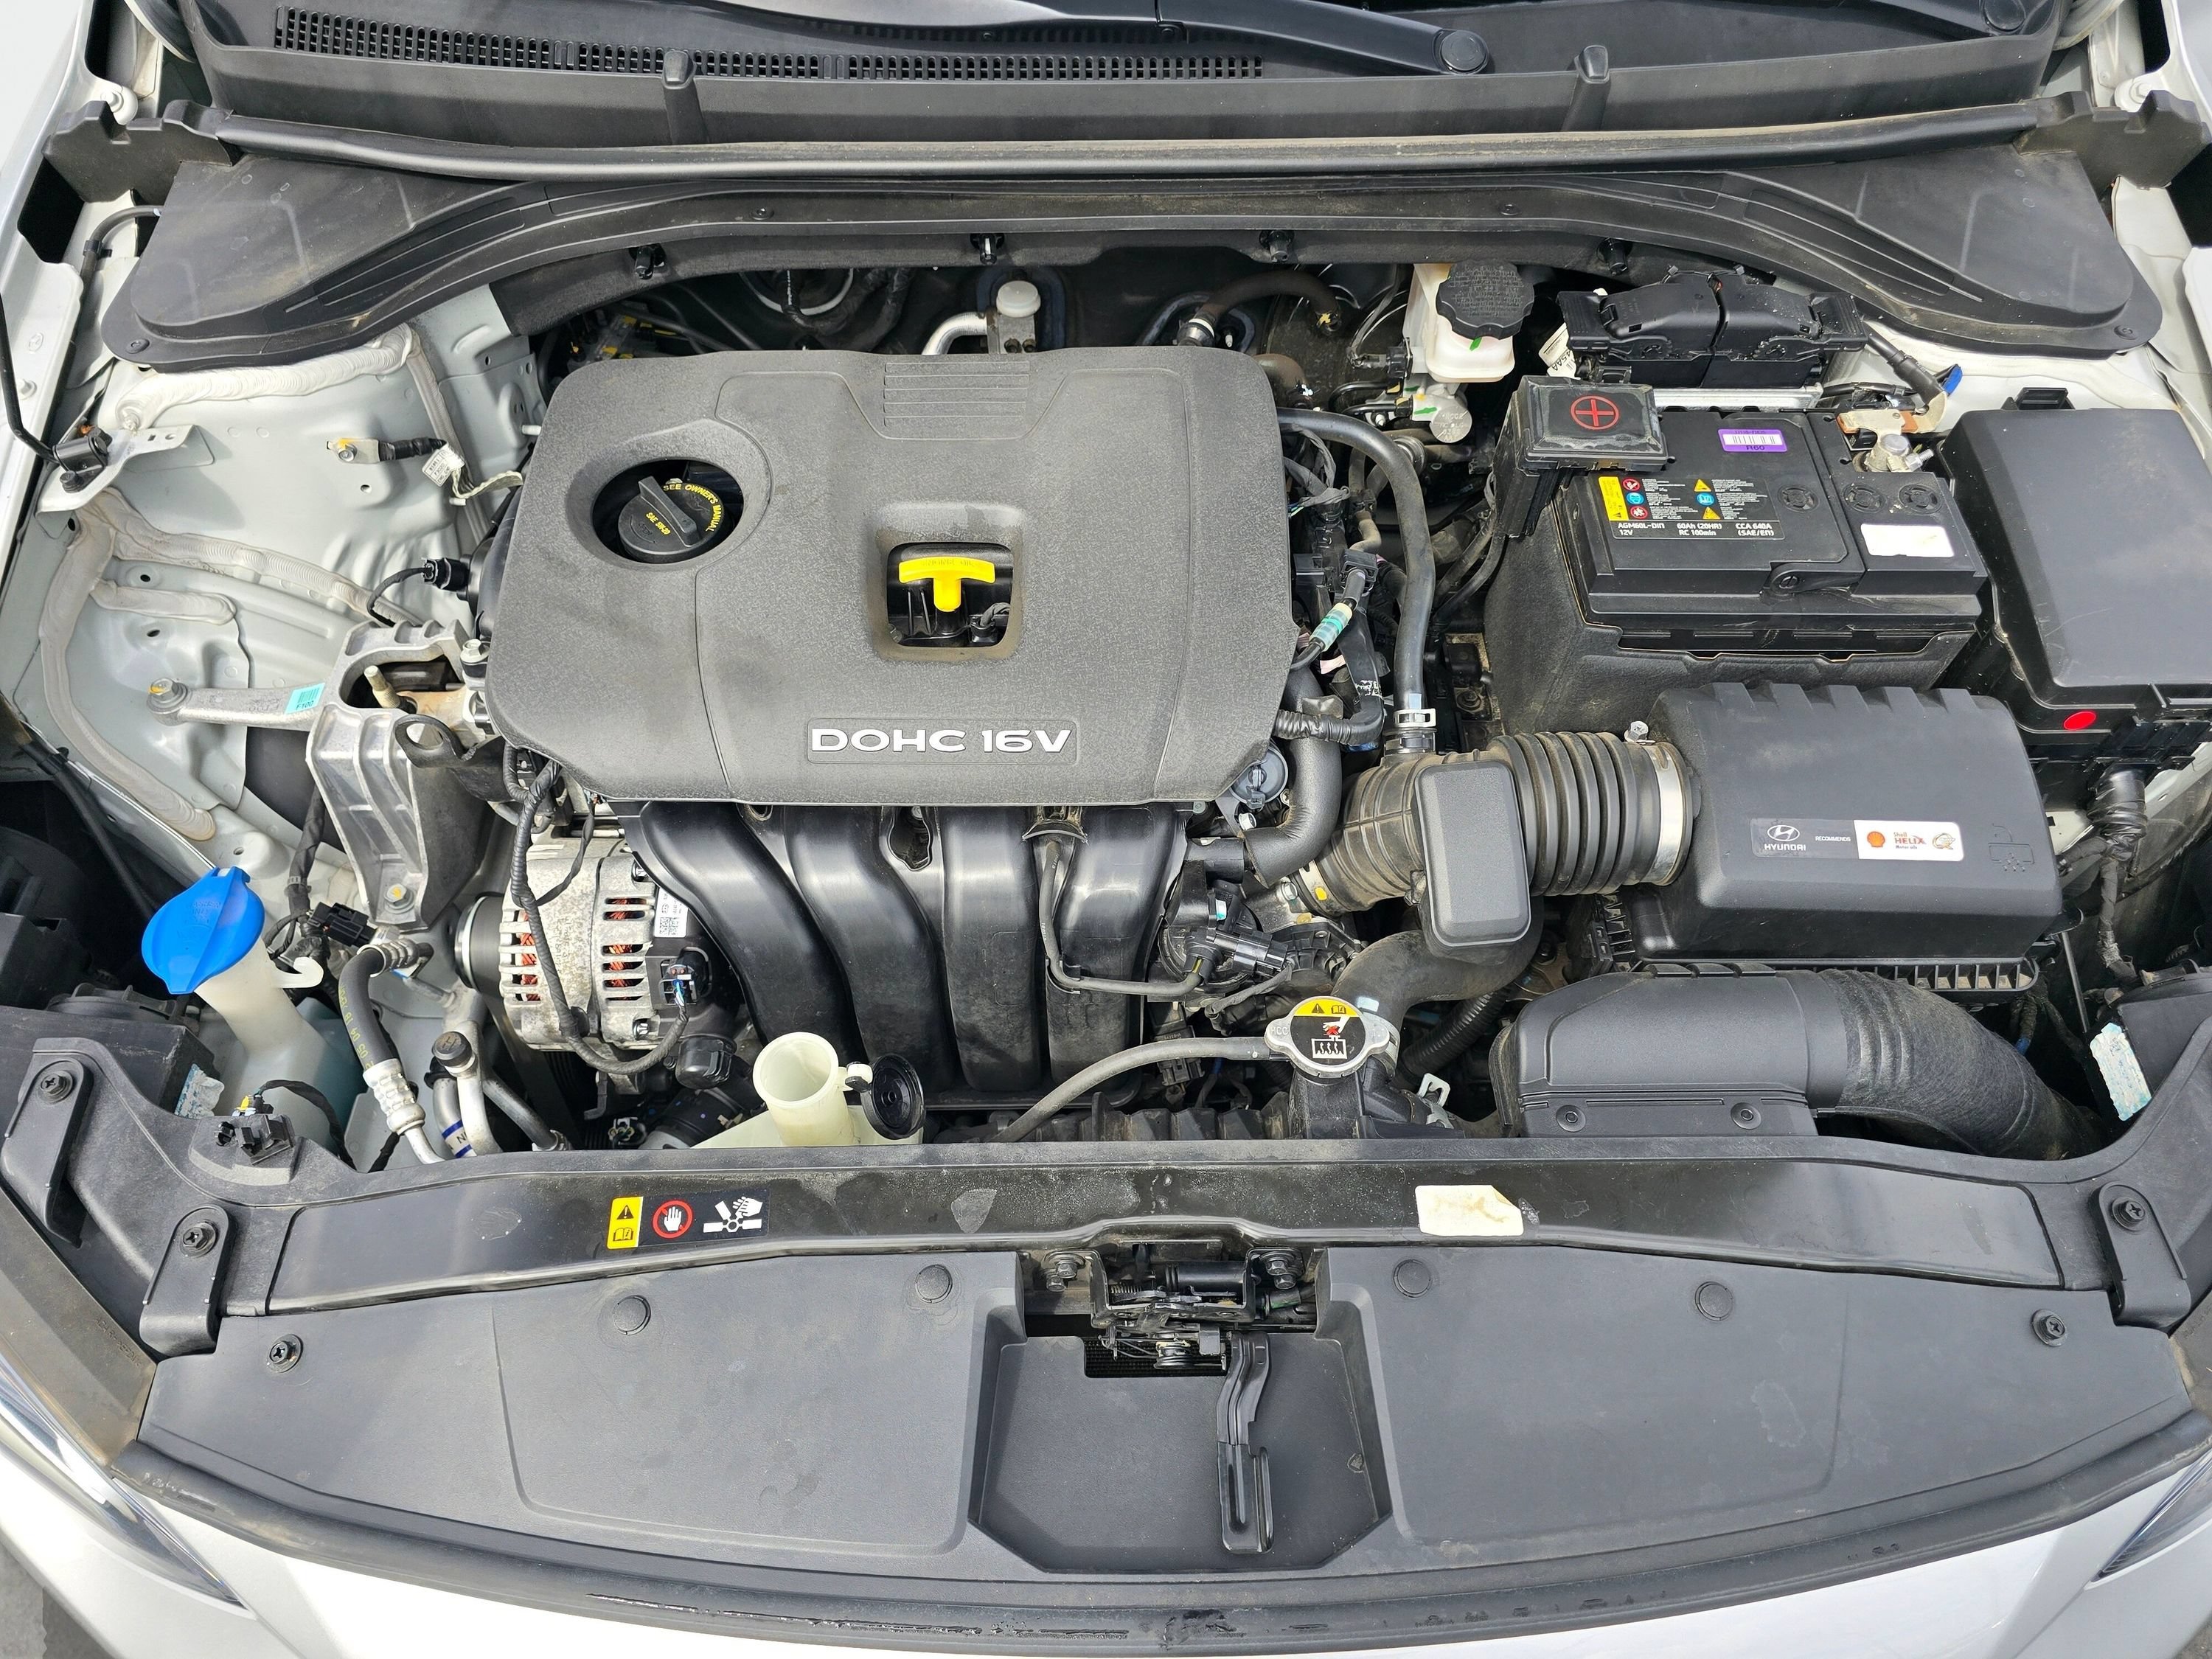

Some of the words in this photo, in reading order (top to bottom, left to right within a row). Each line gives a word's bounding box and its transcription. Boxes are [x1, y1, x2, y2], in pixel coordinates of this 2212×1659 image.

[684, 484, 718, 504] OWNER'S
[705, 504, 722, 532] MANUAL
[646, 512, 658, 523] SAE
[296, 700, 314, 710] F100
[811, 728, 967, 753] DOHC
[981, 729, 1072, 754] 16V
[1894, 837, 1926, 845] HELIX
[1764, 843, 1806, 851] HYUNDAI
[1270, 1026, 1289, 1035] HCC
